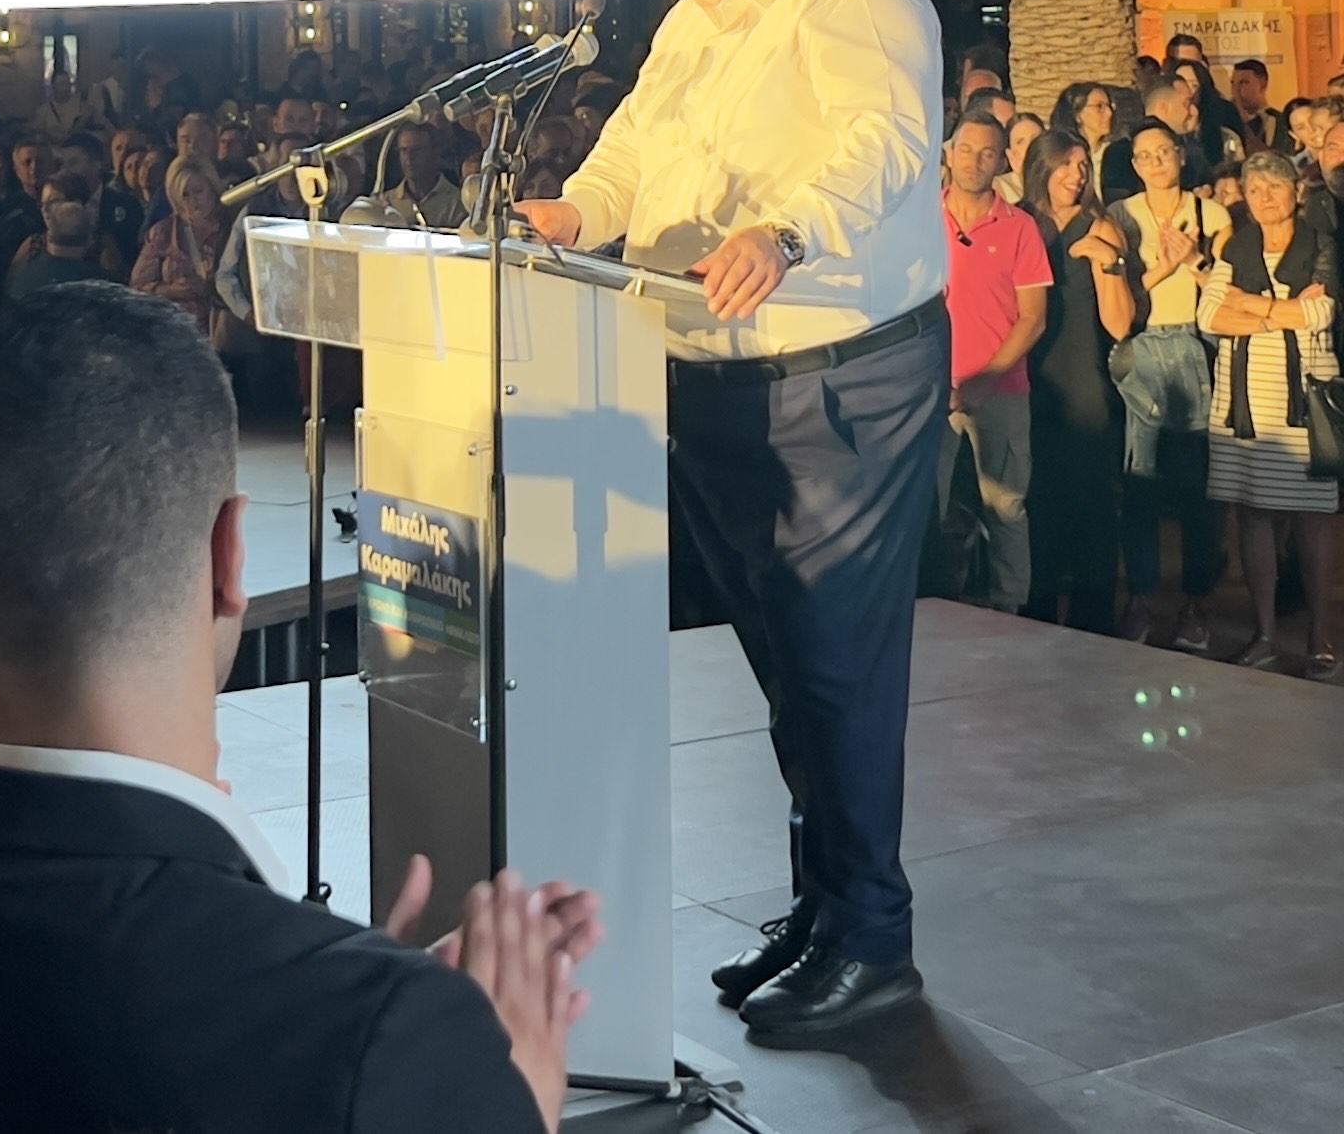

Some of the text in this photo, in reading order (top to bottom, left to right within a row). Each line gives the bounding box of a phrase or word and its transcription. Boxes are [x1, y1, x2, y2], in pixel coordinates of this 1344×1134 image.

[1173, 18, 1281, 34] ΣΜΑΡΑΓΔΑΚΗΣ
[381, 505, 450, 557] Μιχάλης
[361, 544, 472, 609] Καραμαλάκης
